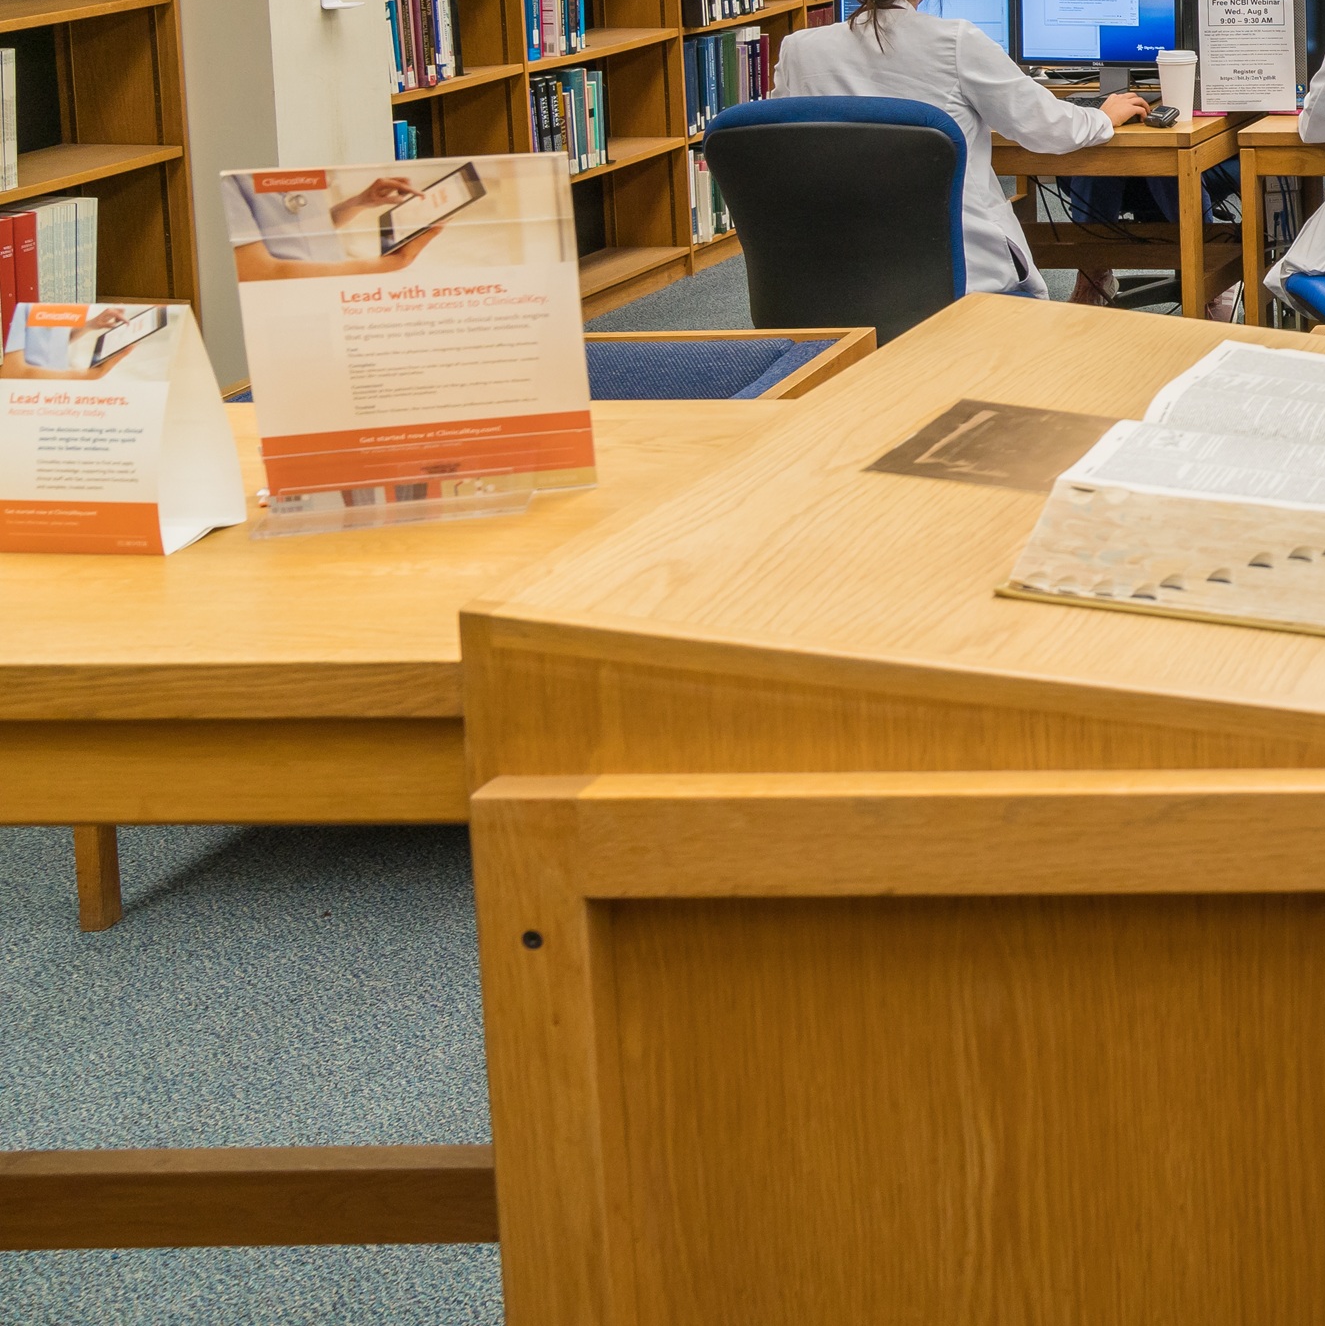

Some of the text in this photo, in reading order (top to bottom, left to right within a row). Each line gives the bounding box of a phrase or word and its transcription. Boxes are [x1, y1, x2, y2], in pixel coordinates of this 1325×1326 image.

[1247, 8, 1262, 16] Aug
[261, 176, 320, 188] ClinicalKey
[340, 283, 507, 304] Lead with answers.
[341, 295, 549, 316] You now have access to ClinicalKey.
[35, 311, 81, 323] ClinicalKey
[9, 392, 129, 405] Lead with answers.
[8, 408, 34, 417] Access
[36, 407, 81, 418] ClinicalKey
[359, 436, 374, 444] Get
[376, 433, 405, 442] started
[407, 432, 425, 440] now
